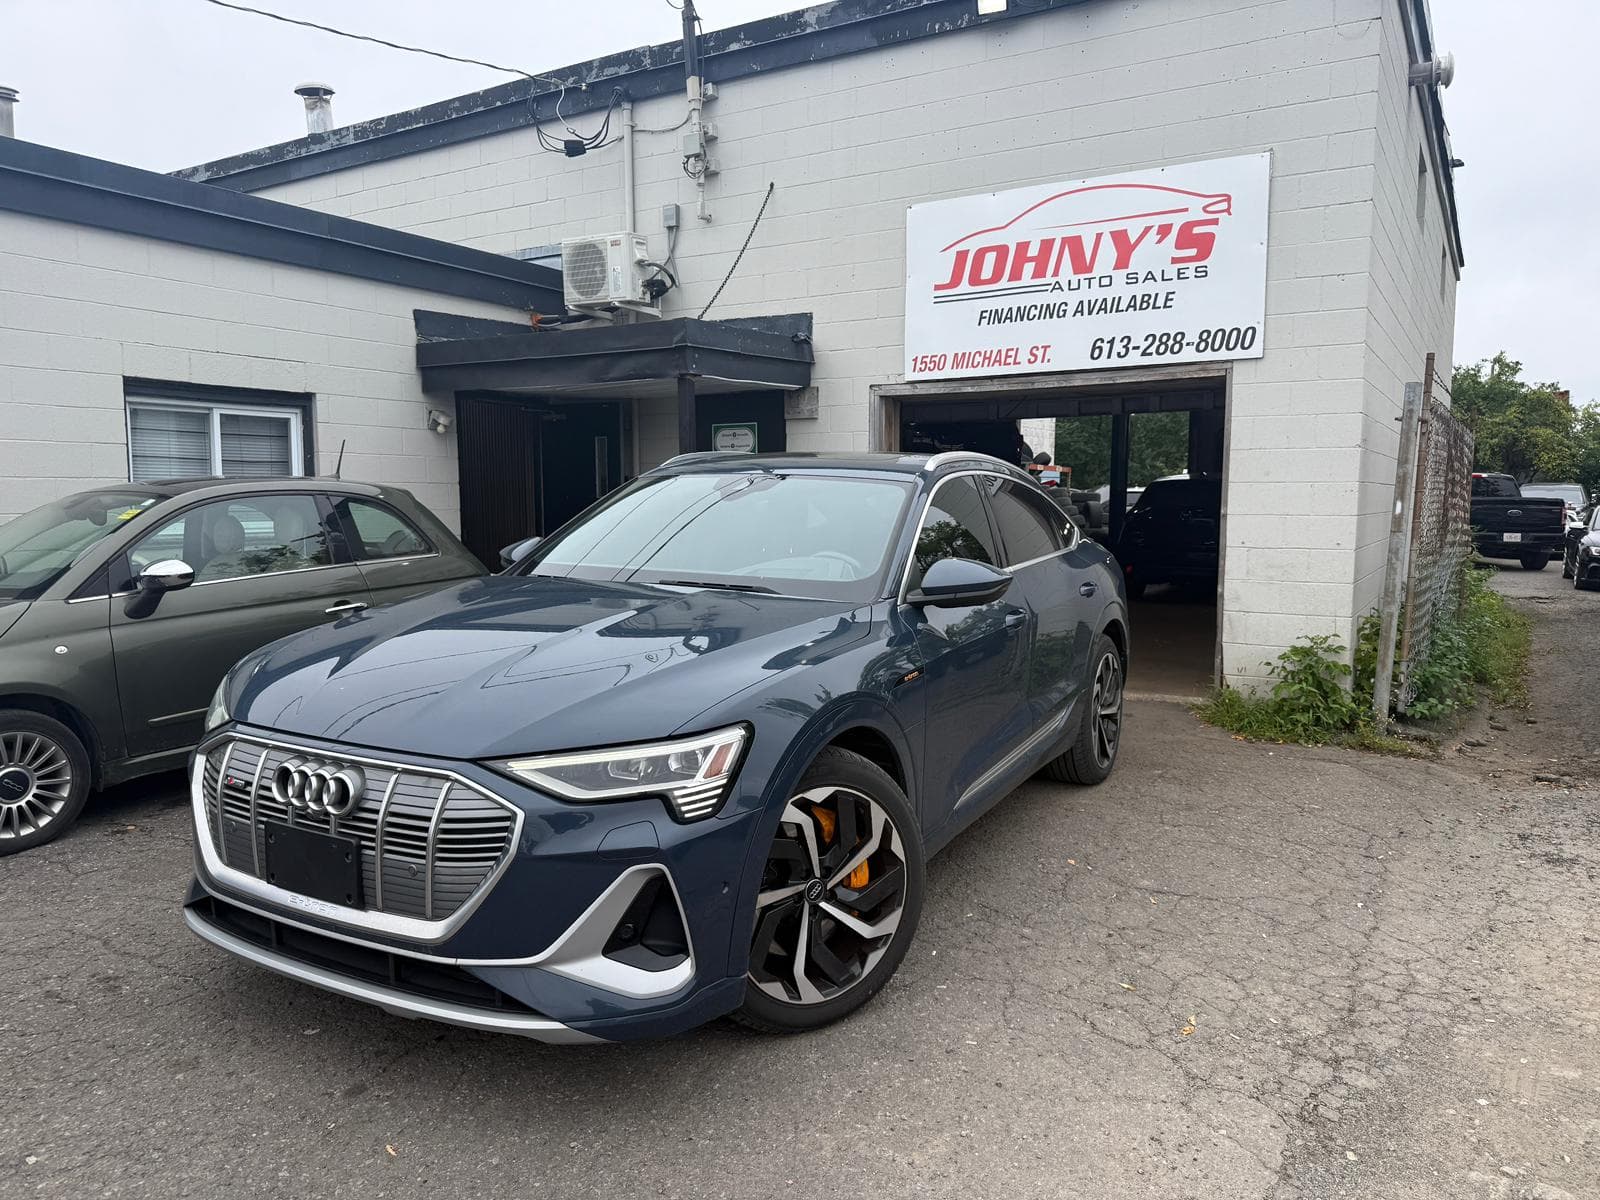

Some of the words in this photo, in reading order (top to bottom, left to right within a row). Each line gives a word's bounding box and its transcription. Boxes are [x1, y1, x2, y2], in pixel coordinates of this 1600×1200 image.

[933, 218, 1220, 292] JOHNY'S
[1050, 275, 1113, 293] AUTO
[1125, 265, 1209, 285] SALES
[977, 301, 1069, 327] FINANCING
[1072, 291, 1176, 318] AVAILABLE
[911, 353, 948, 373] 1550
[951, 347, 1022, 370] MICHAEL
[1027, 345, 1052, 365] ST.
[1089, 326, 1258, 361] 613-288-8000
